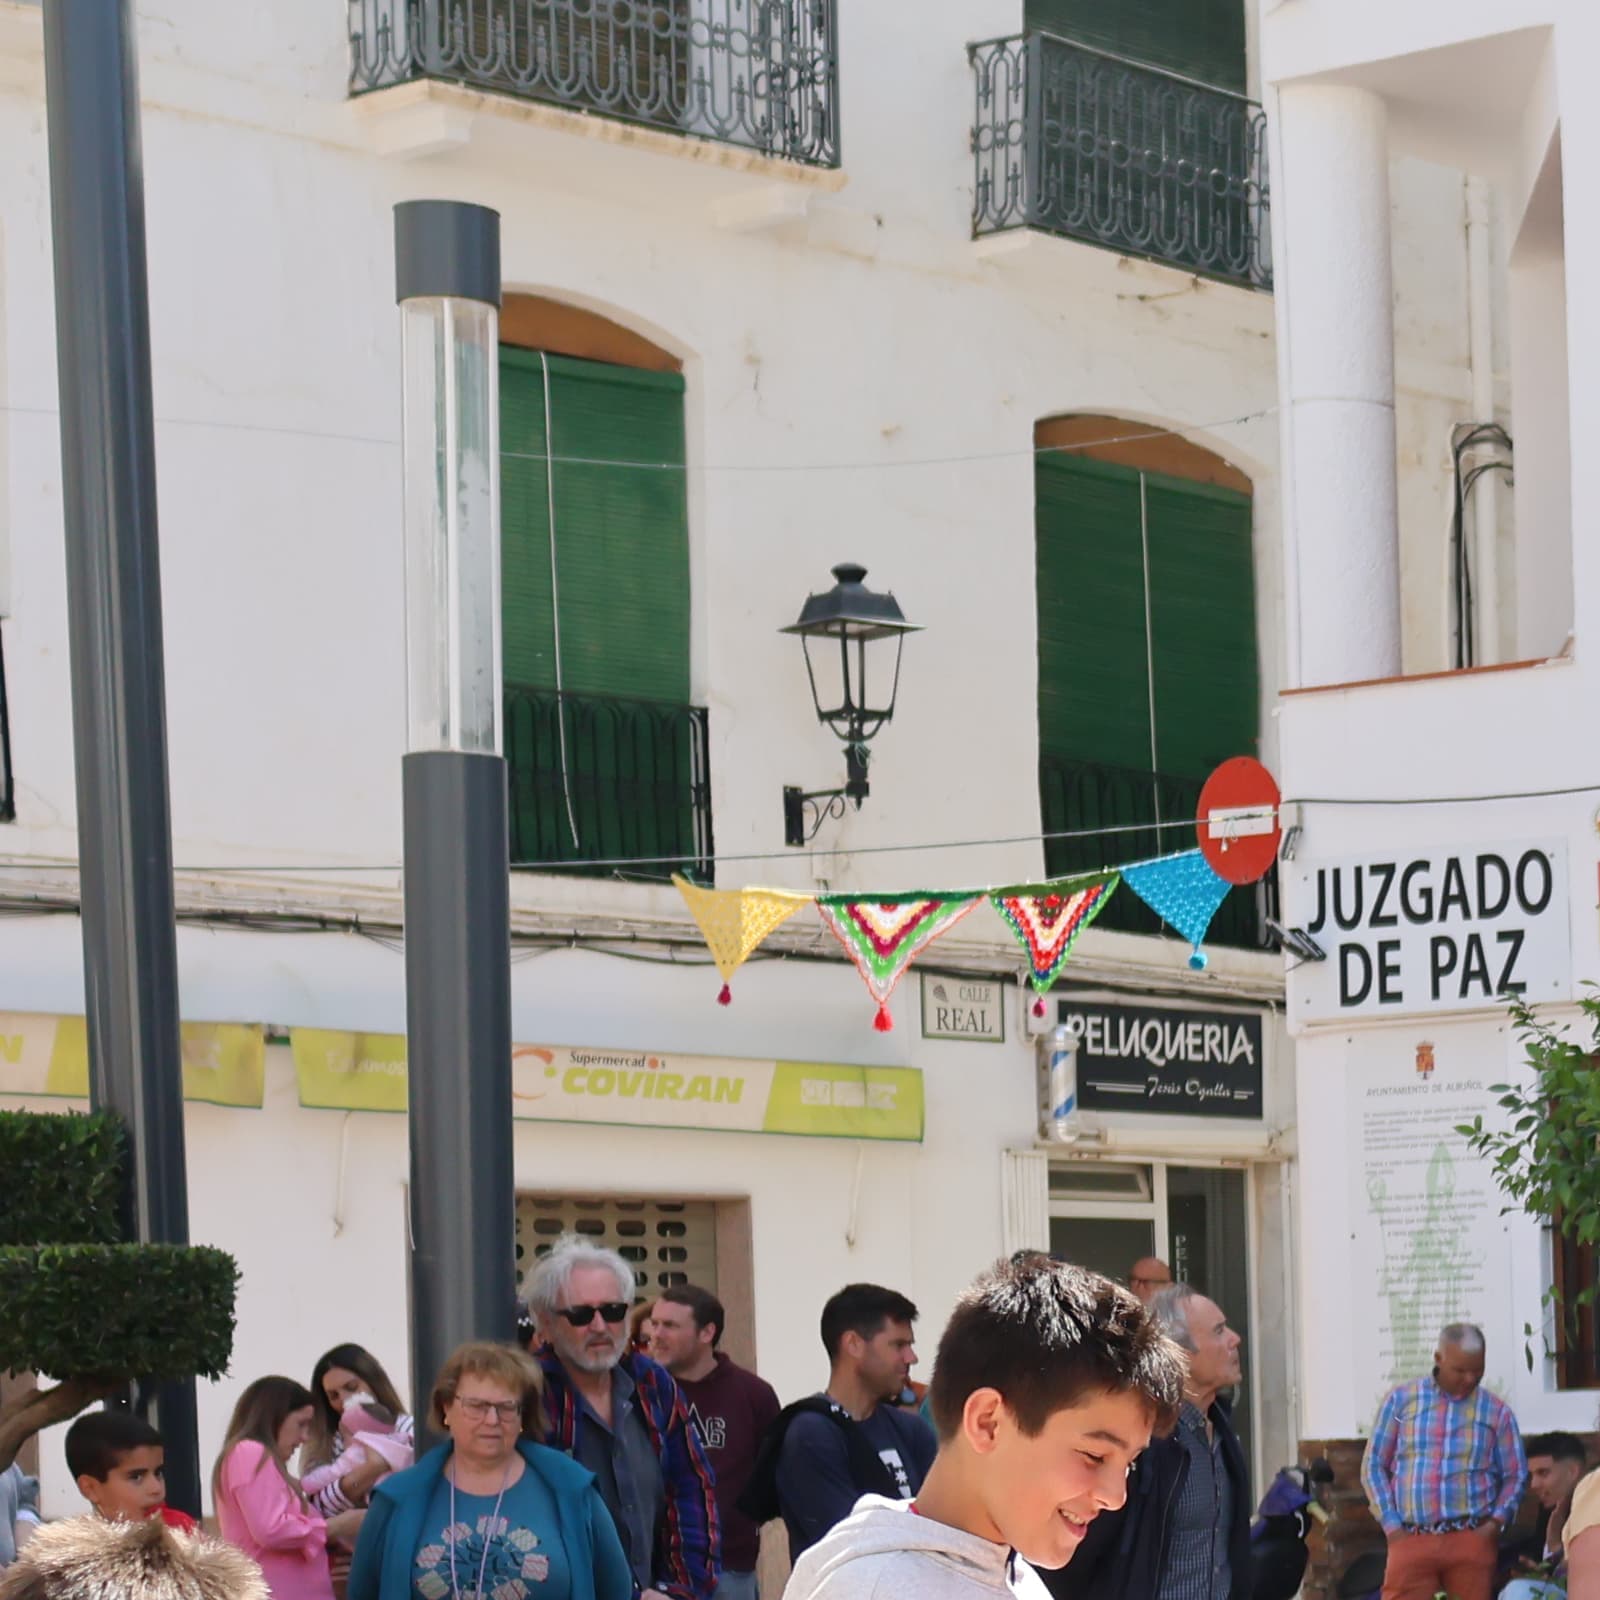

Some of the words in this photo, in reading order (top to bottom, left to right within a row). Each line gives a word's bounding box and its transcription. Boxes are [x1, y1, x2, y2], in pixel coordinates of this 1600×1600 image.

[1307, 848, 1553, 934] JUZGADO
[1339, 939, 1404, 1008] DE
[1429, 929, 1528, 1001] PAZ
[960, 986, 992, 1003] CALLE
[936, 1007, 993, 1034] REAL
[1067, 1013, 1254, 1067] PELUQUERIA
[561, 1067, 746, 1104] COVIRAN
[1366, 1085, 1429, 1097] AYUNTAMIENTO
[1432, 1083, 1443, 1093] DE
